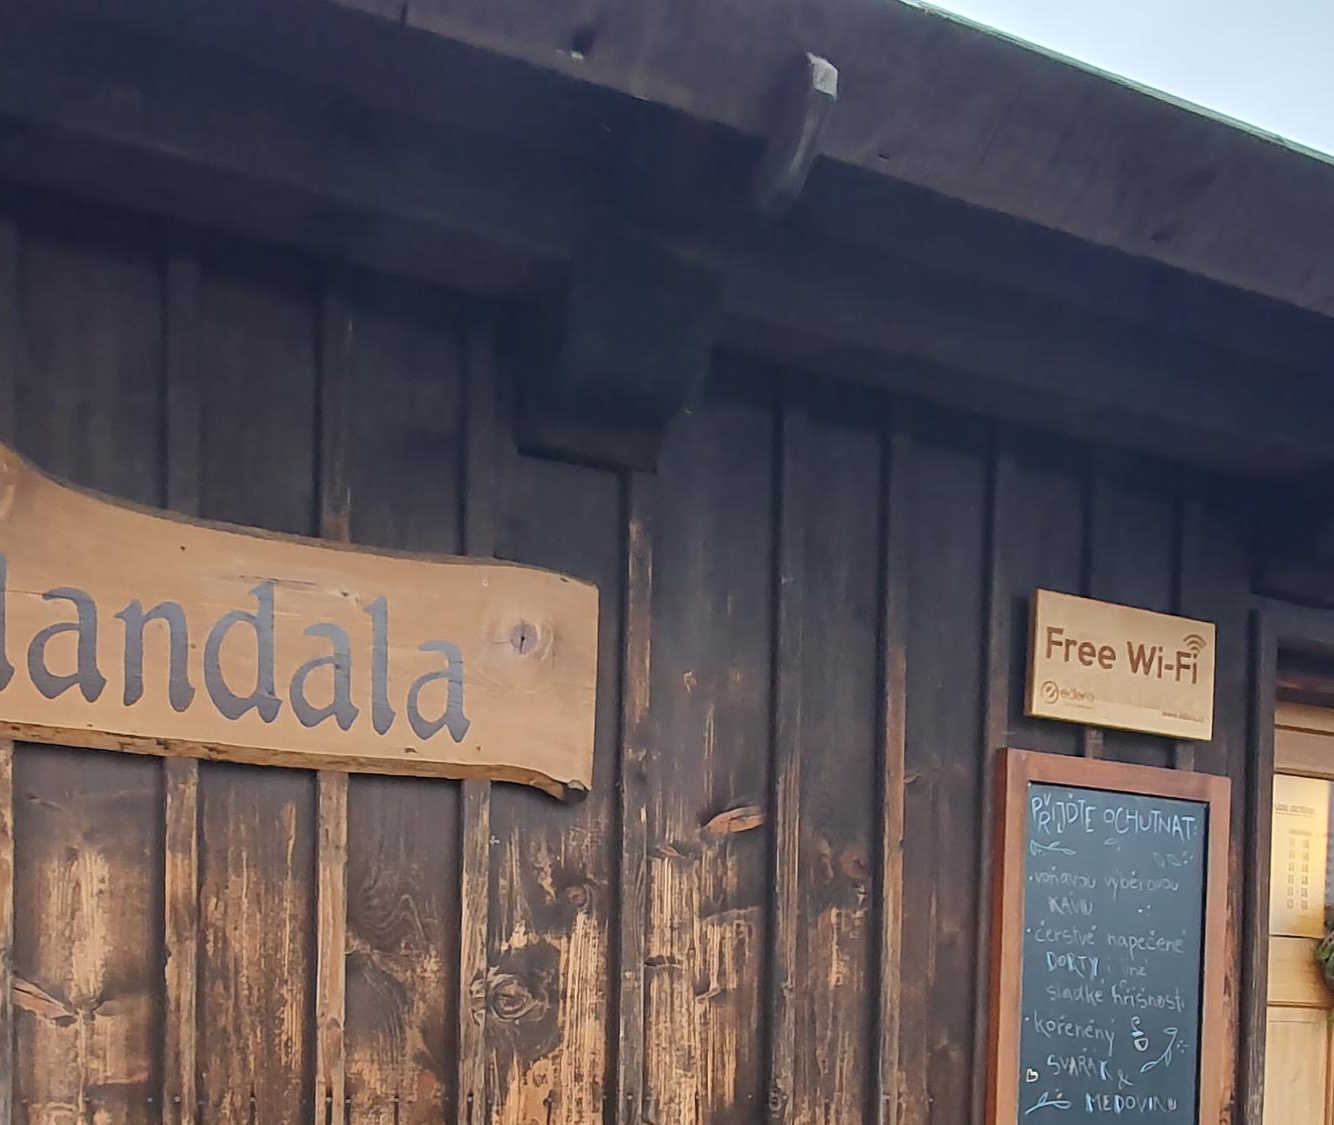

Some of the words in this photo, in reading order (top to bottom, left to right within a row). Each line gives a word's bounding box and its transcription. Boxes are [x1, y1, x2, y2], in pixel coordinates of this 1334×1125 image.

[1045, 626, 1117, 670] Free
[1126, 641, 1198, 685] Wi-Fi
[1047, 952, 1099, 980] DORTY
[1046, 979, 1105, 1006] sladké
[1085, 1092, 1178, 1113] MEDOVINU
